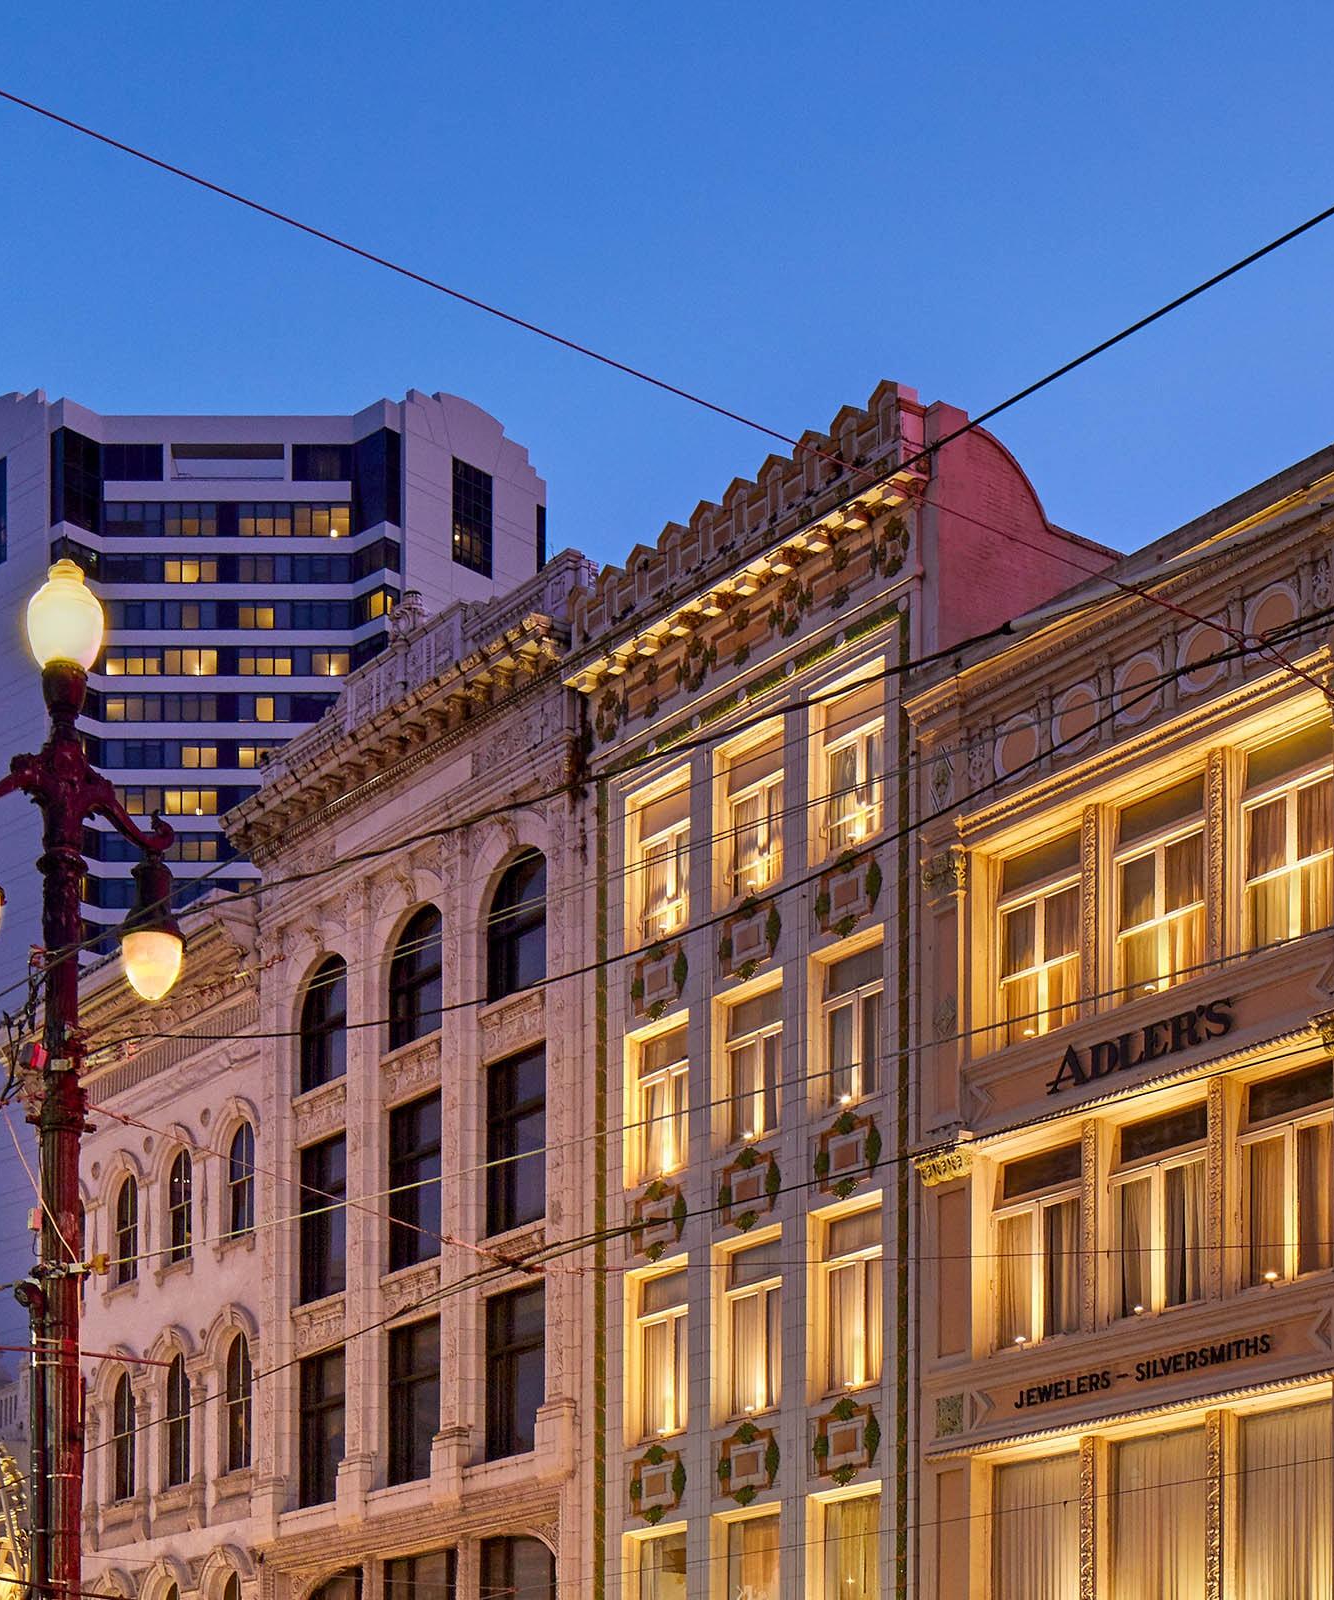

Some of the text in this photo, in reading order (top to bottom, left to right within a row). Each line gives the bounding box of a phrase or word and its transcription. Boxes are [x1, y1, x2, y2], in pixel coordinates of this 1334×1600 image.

[1045, 997, 1234, 1095] ADLER'S
[1014, 1371, 1111, 1409] JEWELERS
[1135, 1334, 1271, 1382] SILVERSMITHS
